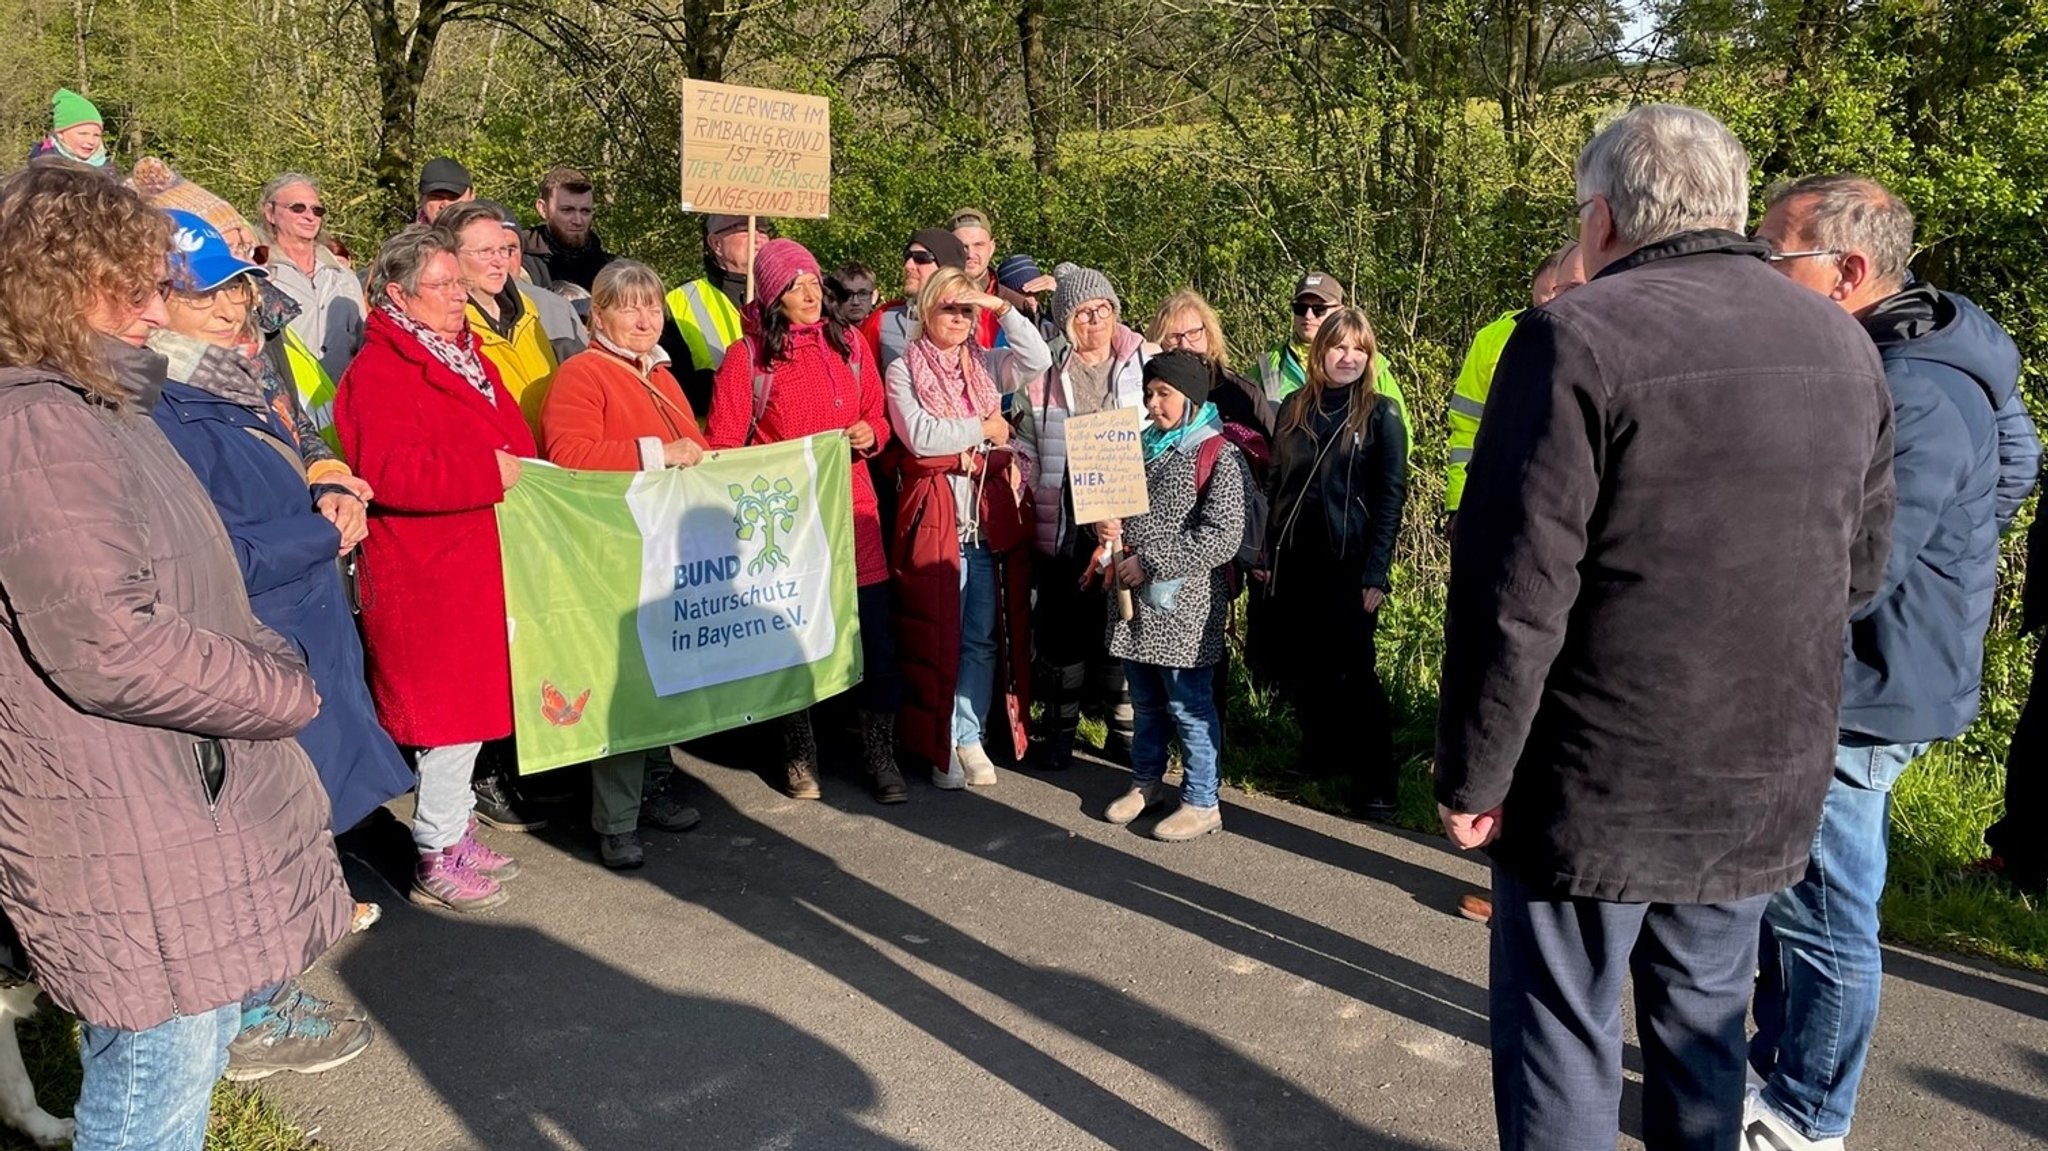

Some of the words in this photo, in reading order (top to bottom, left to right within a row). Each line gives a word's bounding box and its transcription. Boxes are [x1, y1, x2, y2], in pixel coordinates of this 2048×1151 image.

[696, 89, 798, 122] FEUERWERK
[804, 105, 825, 125] IM
[693, 117, 825, 152] RIMBACHGRUND
[726, 144, 755, 164] IST
[686, 158, 723, 181] TIER
[728, 164, 765, 184] UND
[766, 168, 830, 190] MENSCH
[1095, 429, 1136, 442] wenn
[1073, 472, 1105, 486] HIER
[674, 555, 742, 590] BUND
[674, 580, 799, 622] Naturschutz
[672, 629, 690, 652] in
[697, 618, 767, 648] Bayern
[772, 605, 808, 631] e.V.
